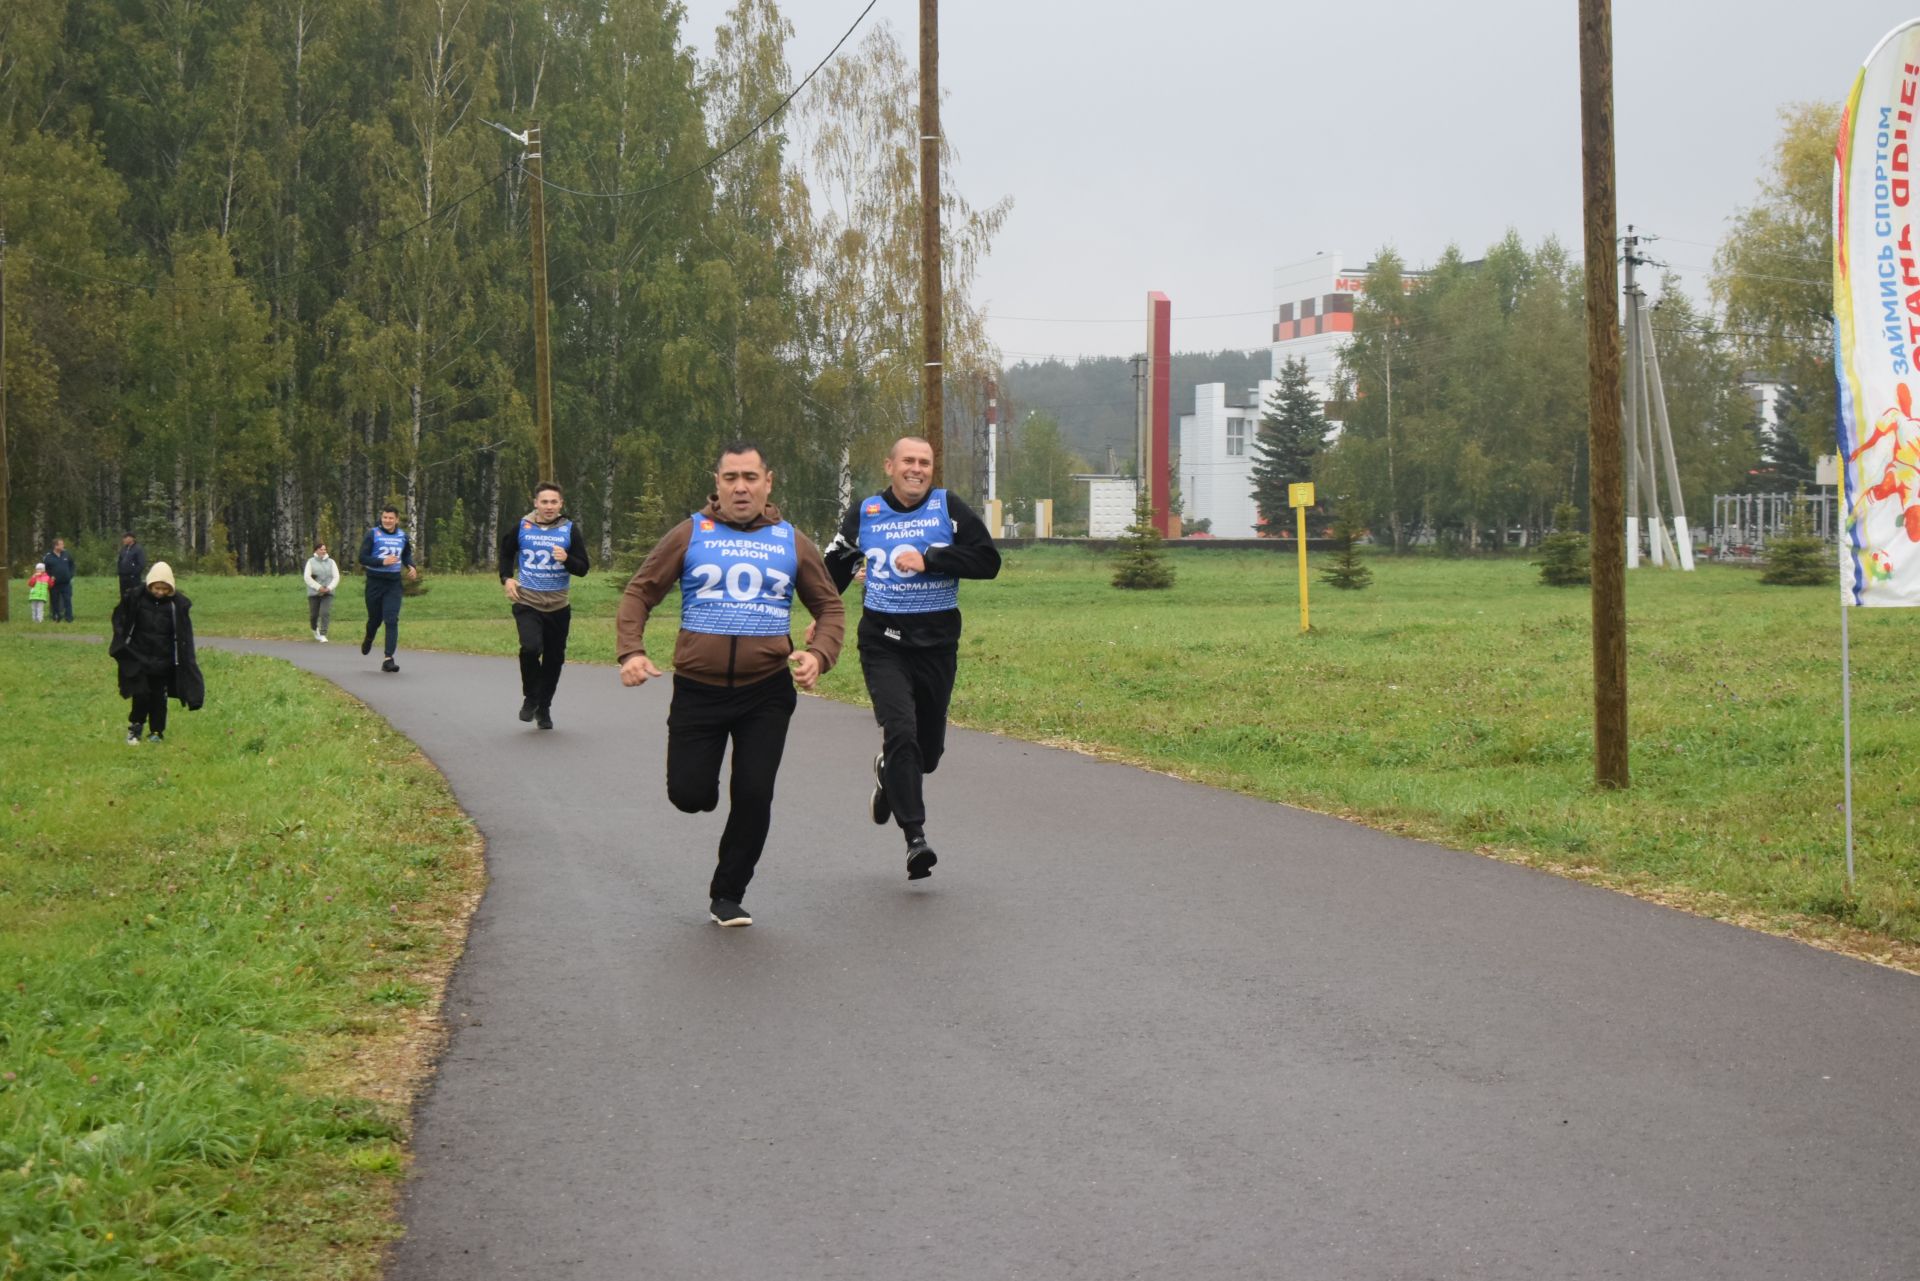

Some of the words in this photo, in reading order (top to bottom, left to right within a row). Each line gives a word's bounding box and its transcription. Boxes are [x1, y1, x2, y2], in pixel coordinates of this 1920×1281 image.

[1874, 106, 1892, 237] СПОРТОМ
[1877, 245, 1909, 374] ЗАЙМИСЬ
[871, 517, 940, 532] ТУКАЕВСКИЙ
[885, 528, 925, 540] РАЙОН
[703, 539, 785, 556] ТУКАЕВСКИЙ
[721, 547, 769, 561] РАЙОН
[865, 543, 950, 579] 20
